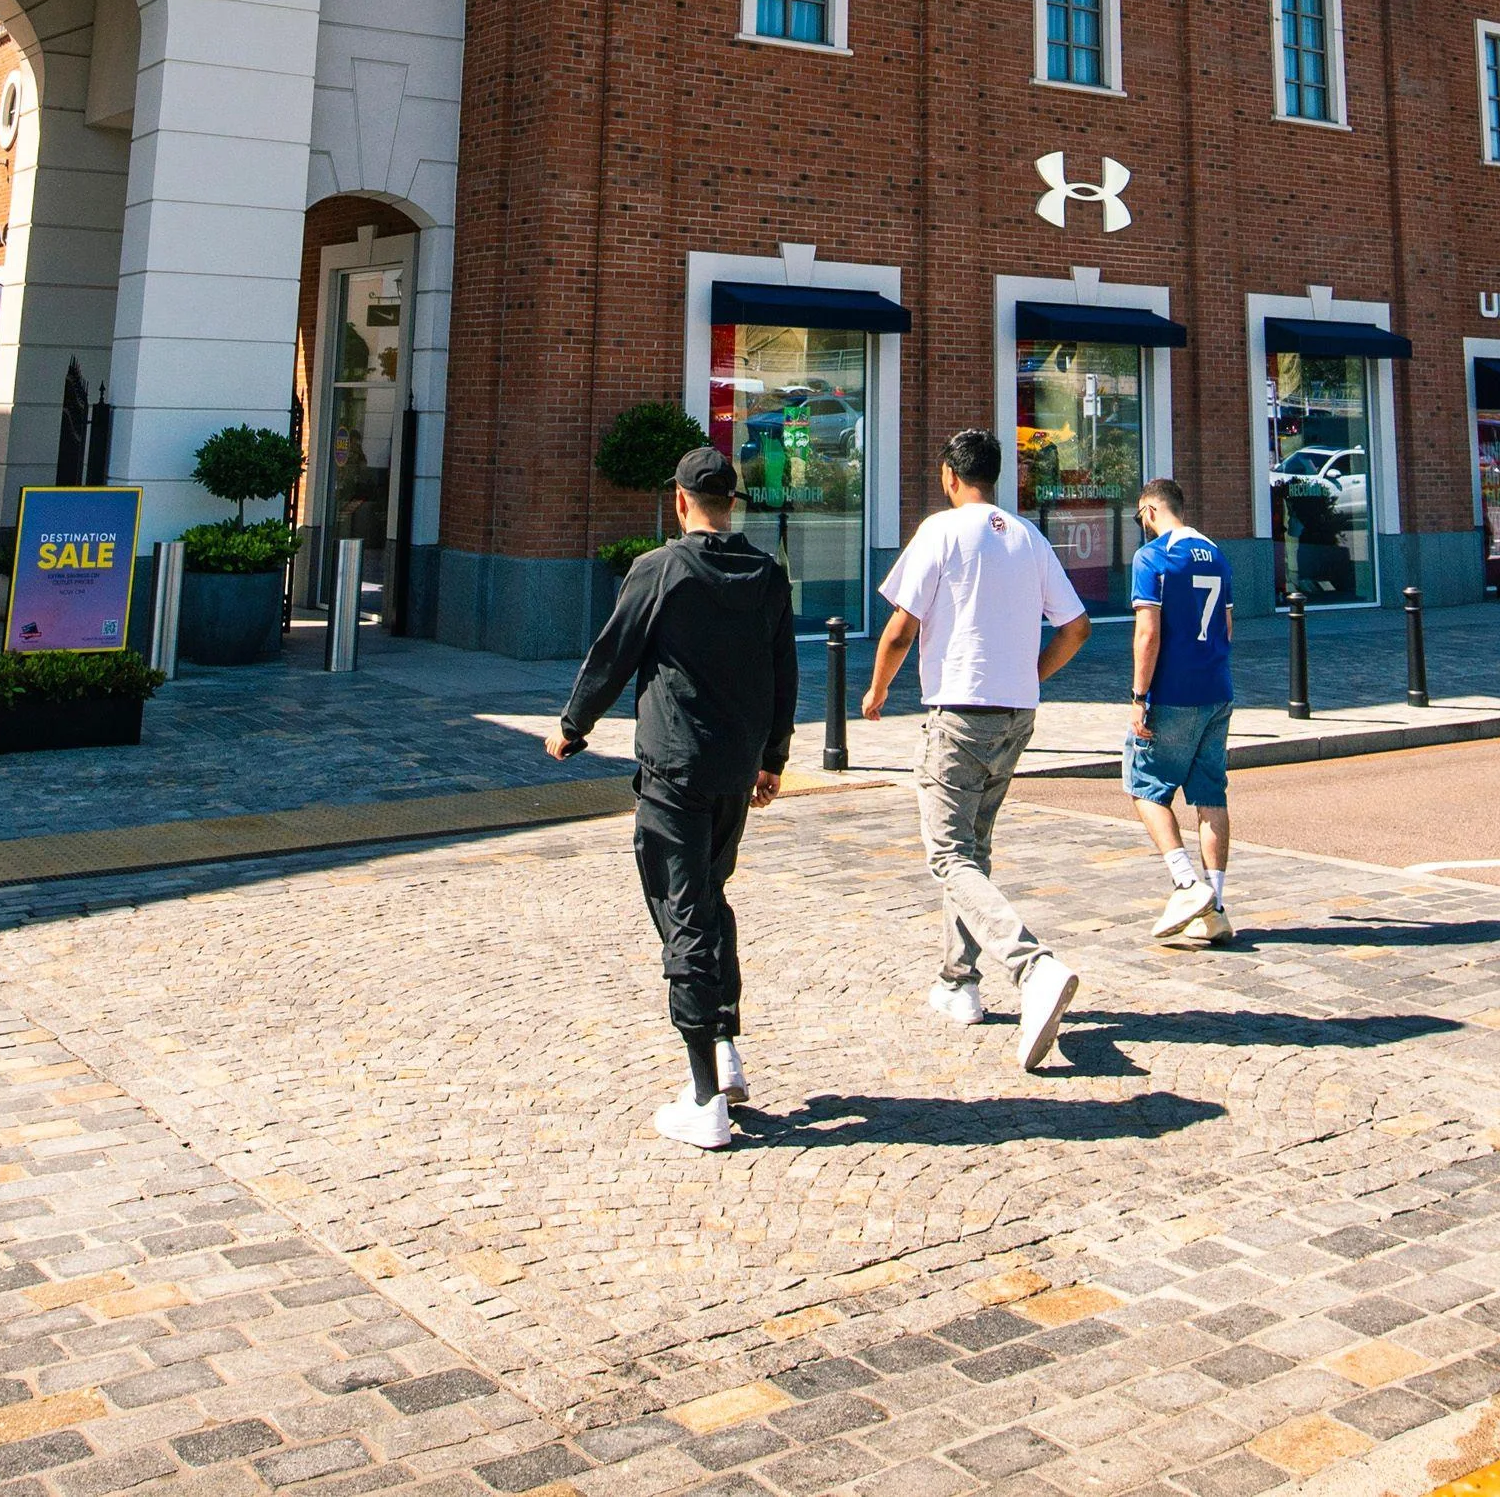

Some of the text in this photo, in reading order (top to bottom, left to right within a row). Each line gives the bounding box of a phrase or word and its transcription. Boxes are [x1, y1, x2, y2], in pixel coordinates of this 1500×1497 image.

[748, 487, 779, 503] TRAIN
[1077, 484, 1121, 500] STRONGER
[41, 533, 116, 542] DESTINATION
[37, 543, 114, 569] SALE
[1190, 548, 1213, 562] JEDI
[1192, 575, 1221, 641] 7
